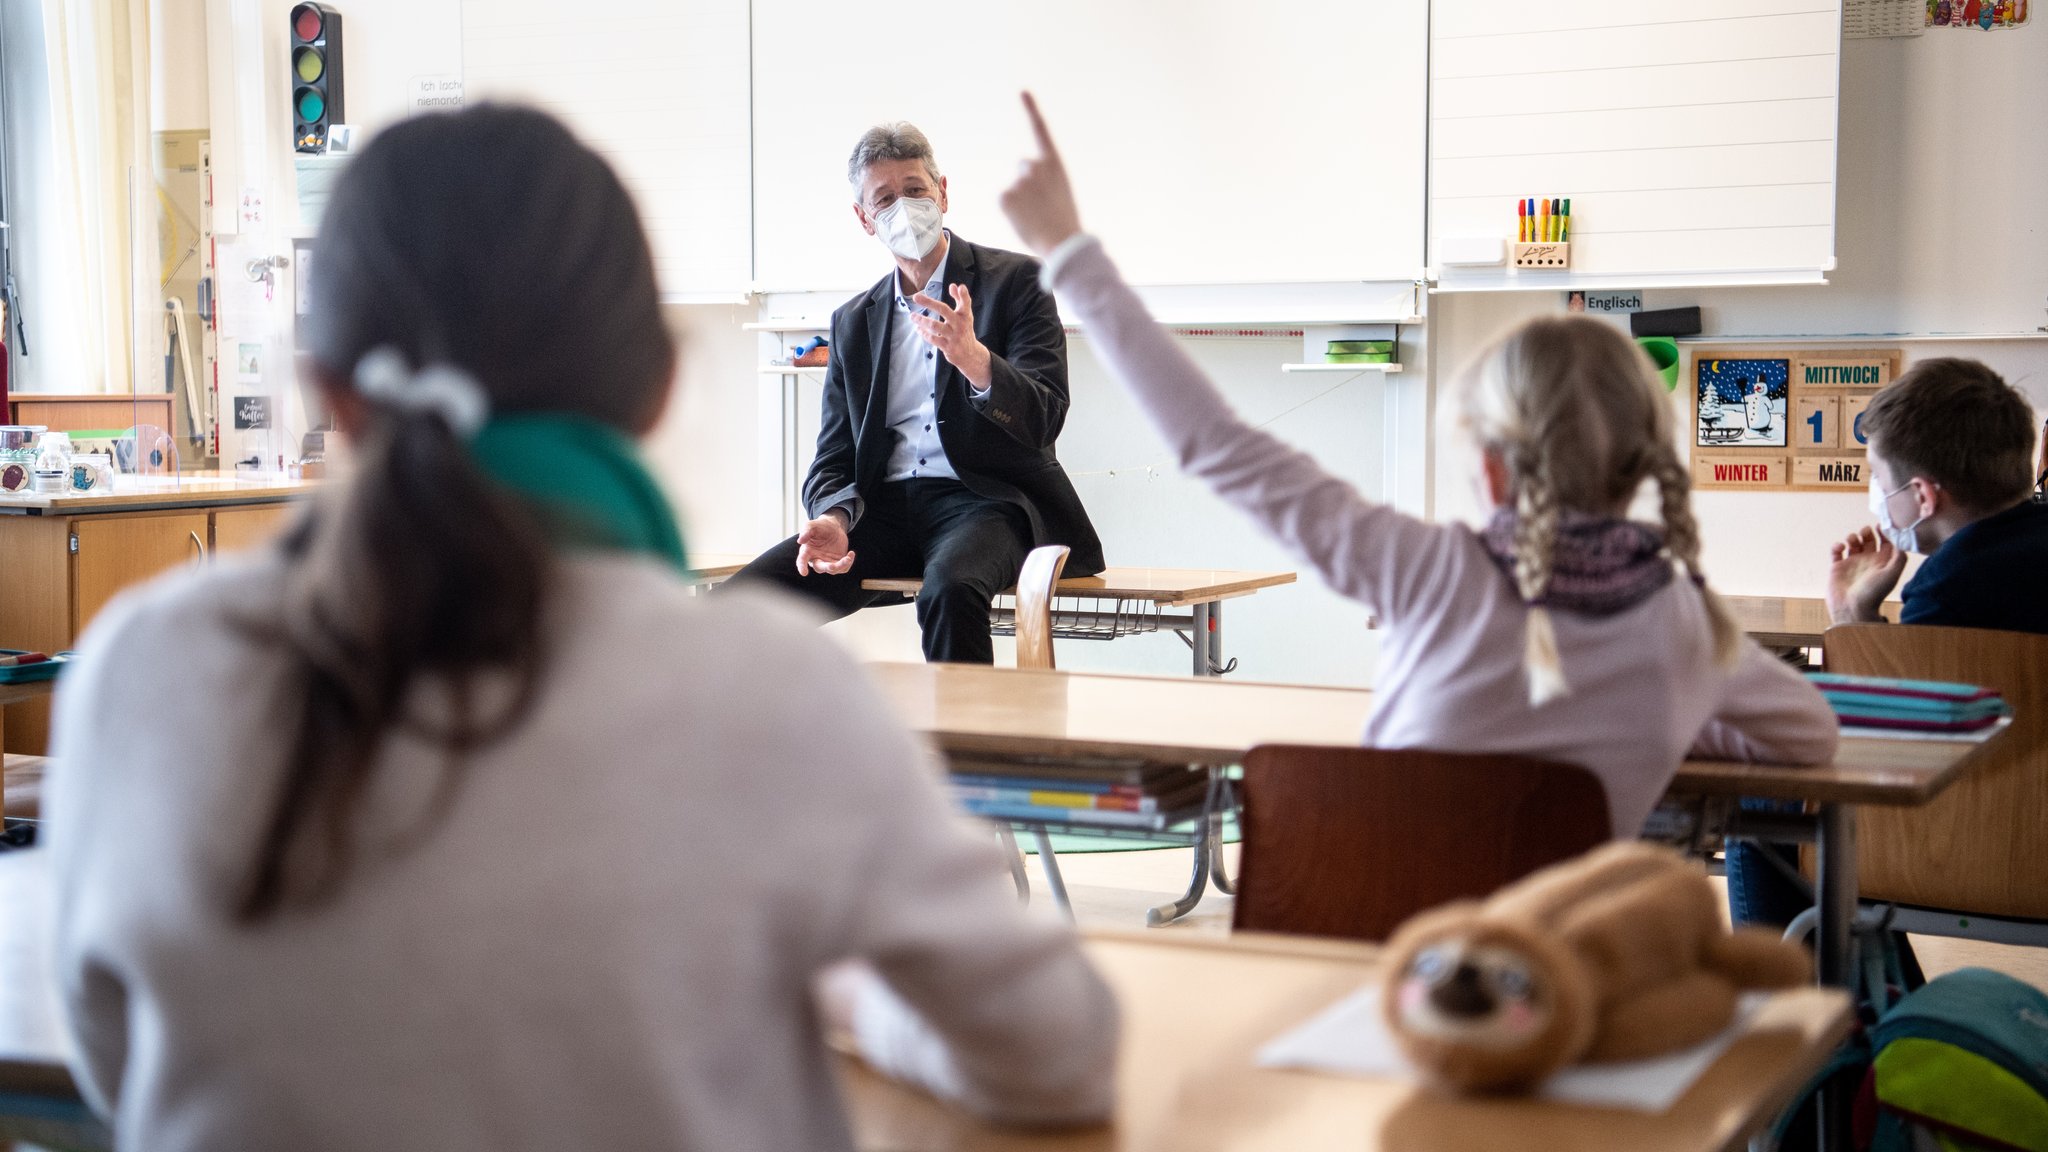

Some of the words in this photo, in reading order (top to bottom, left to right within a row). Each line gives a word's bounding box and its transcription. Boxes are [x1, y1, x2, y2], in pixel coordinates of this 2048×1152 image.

[421, 80, 435, 92] Ich
[1588, 295, 1641, 311] Englisch
[1805, 366, 1879, 384] MITTWOCH
[1714, 464, 1768, 481] WINTER
[1819, 461, 1861, 482] MÄRZ
